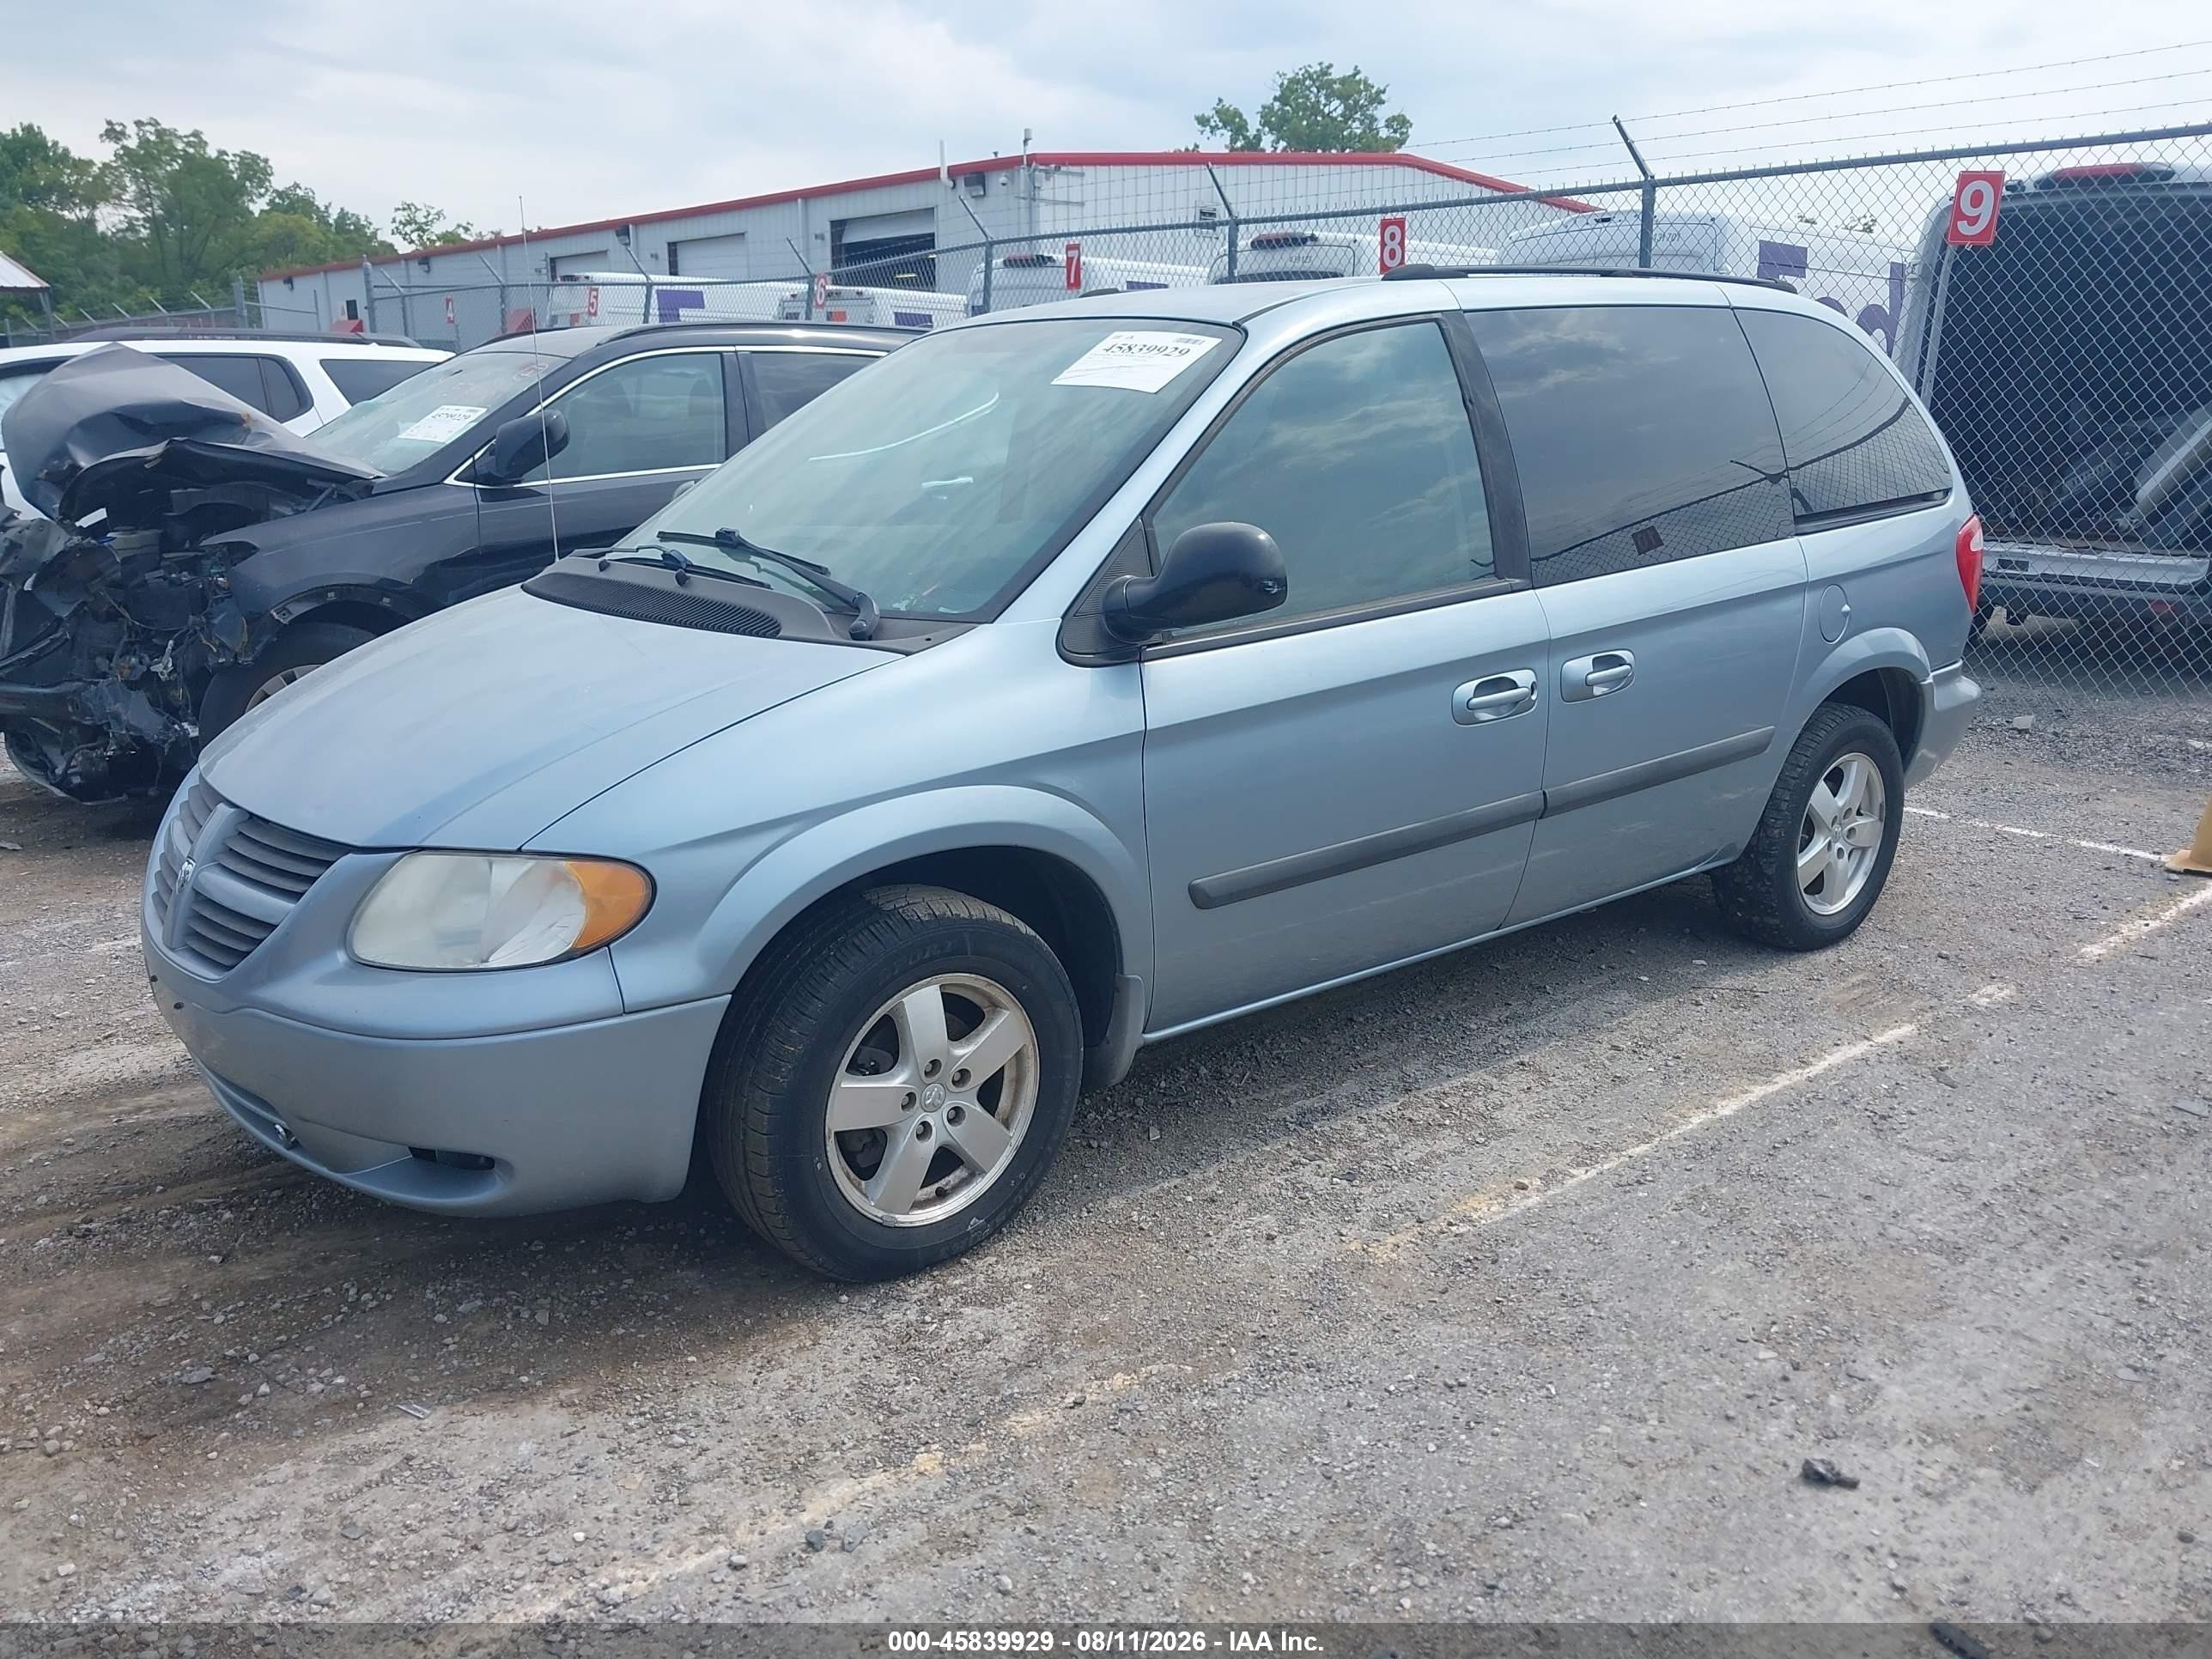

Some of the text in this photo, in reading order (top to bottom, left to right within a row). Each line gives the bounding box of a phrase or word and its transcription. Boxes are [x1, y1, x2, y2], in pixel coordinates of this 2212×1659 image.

[1957, 179, 1994, 235] 9
[1383, 225, 1401, 267] 8
[1067, 250, 1079, 283] 7
[590, 291, 597, 313] 5
[817, 277, 824, 304] 6
[1103, 343, 1190, 357] 45839929
